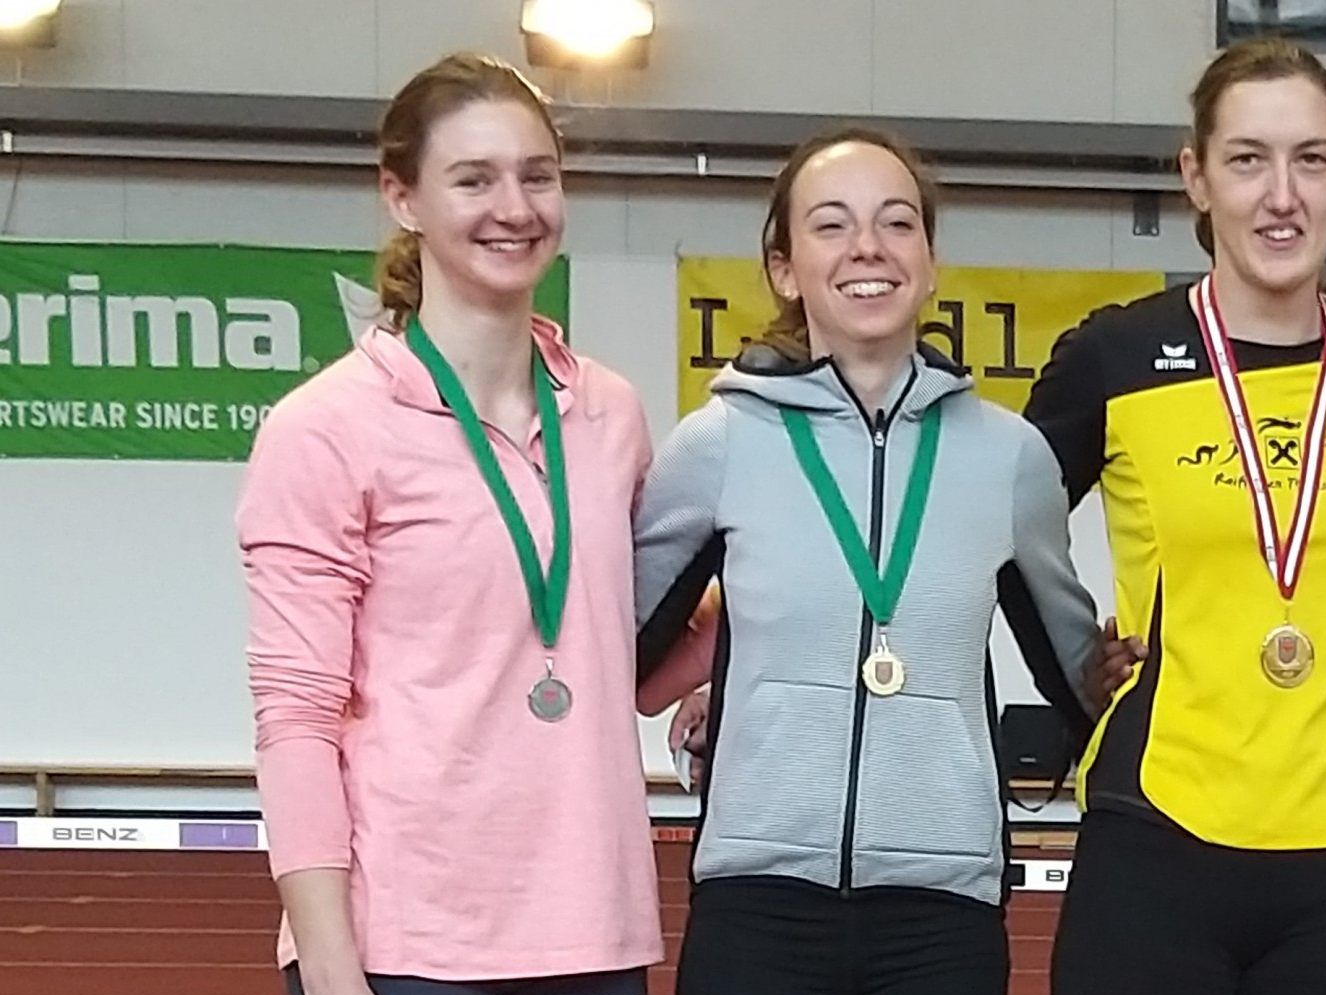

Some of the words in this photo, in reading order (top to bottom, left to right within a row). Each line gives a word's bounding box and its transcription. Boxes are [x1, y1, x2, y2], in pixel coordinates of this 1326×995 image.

[0, 274, 301, 371] rima
[136, 401, 219, 430] SINCE
[53, 827, 138, 841] BENZ
